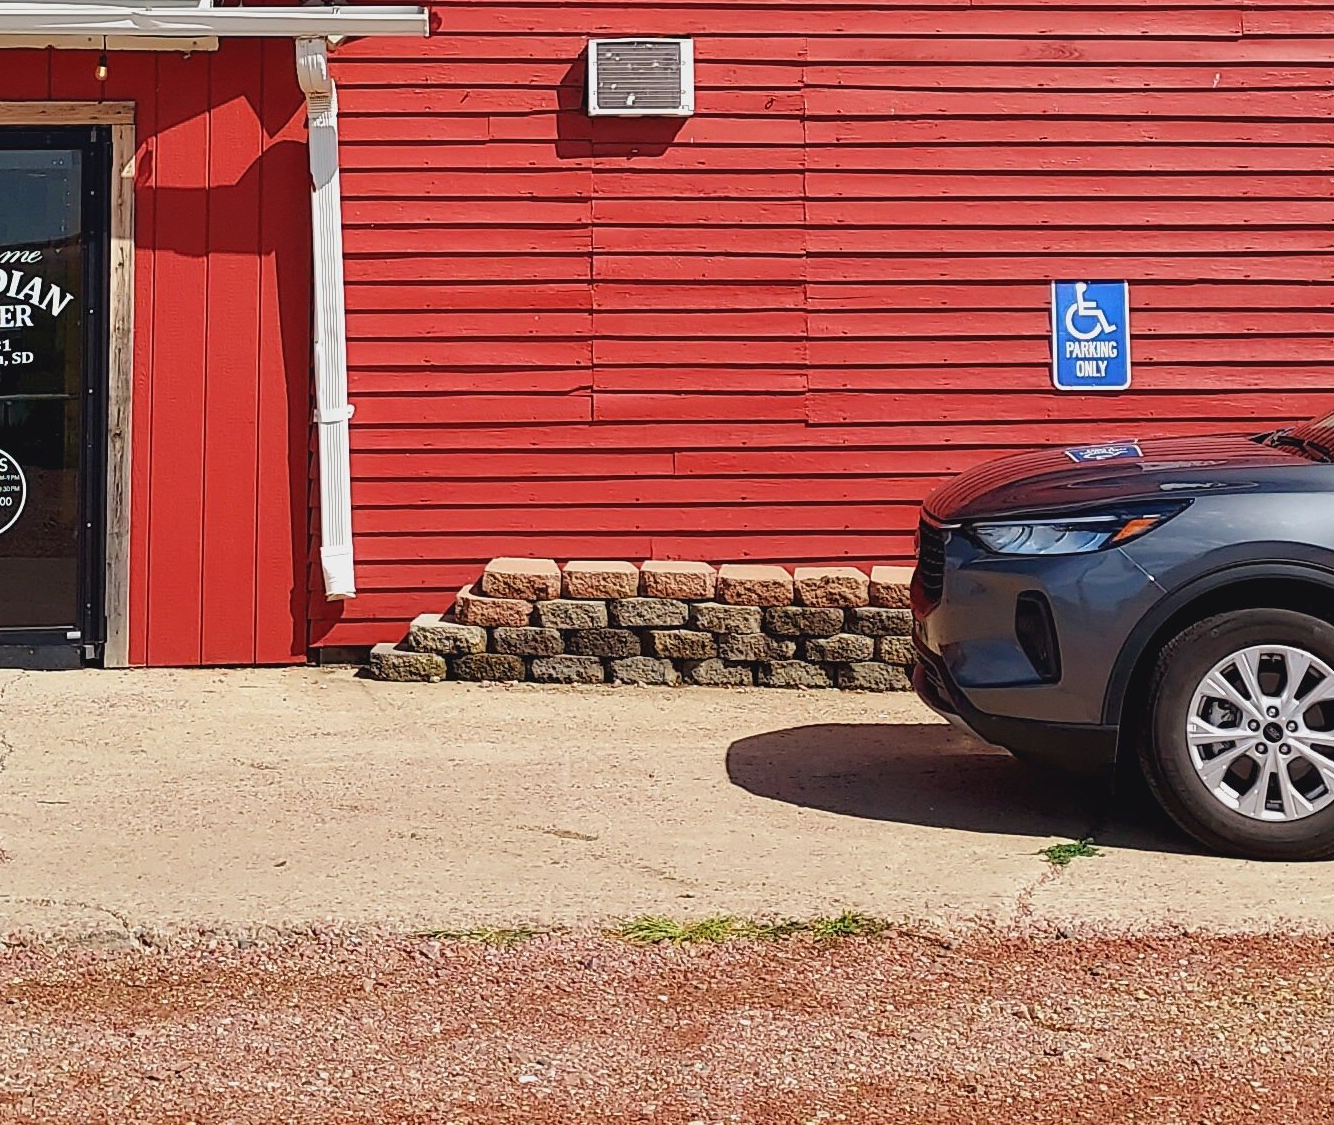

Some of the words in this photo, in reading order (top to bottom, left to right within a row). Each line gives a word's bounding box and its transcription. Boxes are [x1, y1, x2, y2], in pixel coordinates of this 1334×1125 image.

[11, 351, 35, 365] SD
[1066, 341, 1118, 358] PARKING
[1075, 359, 1108, 378] ONLY
